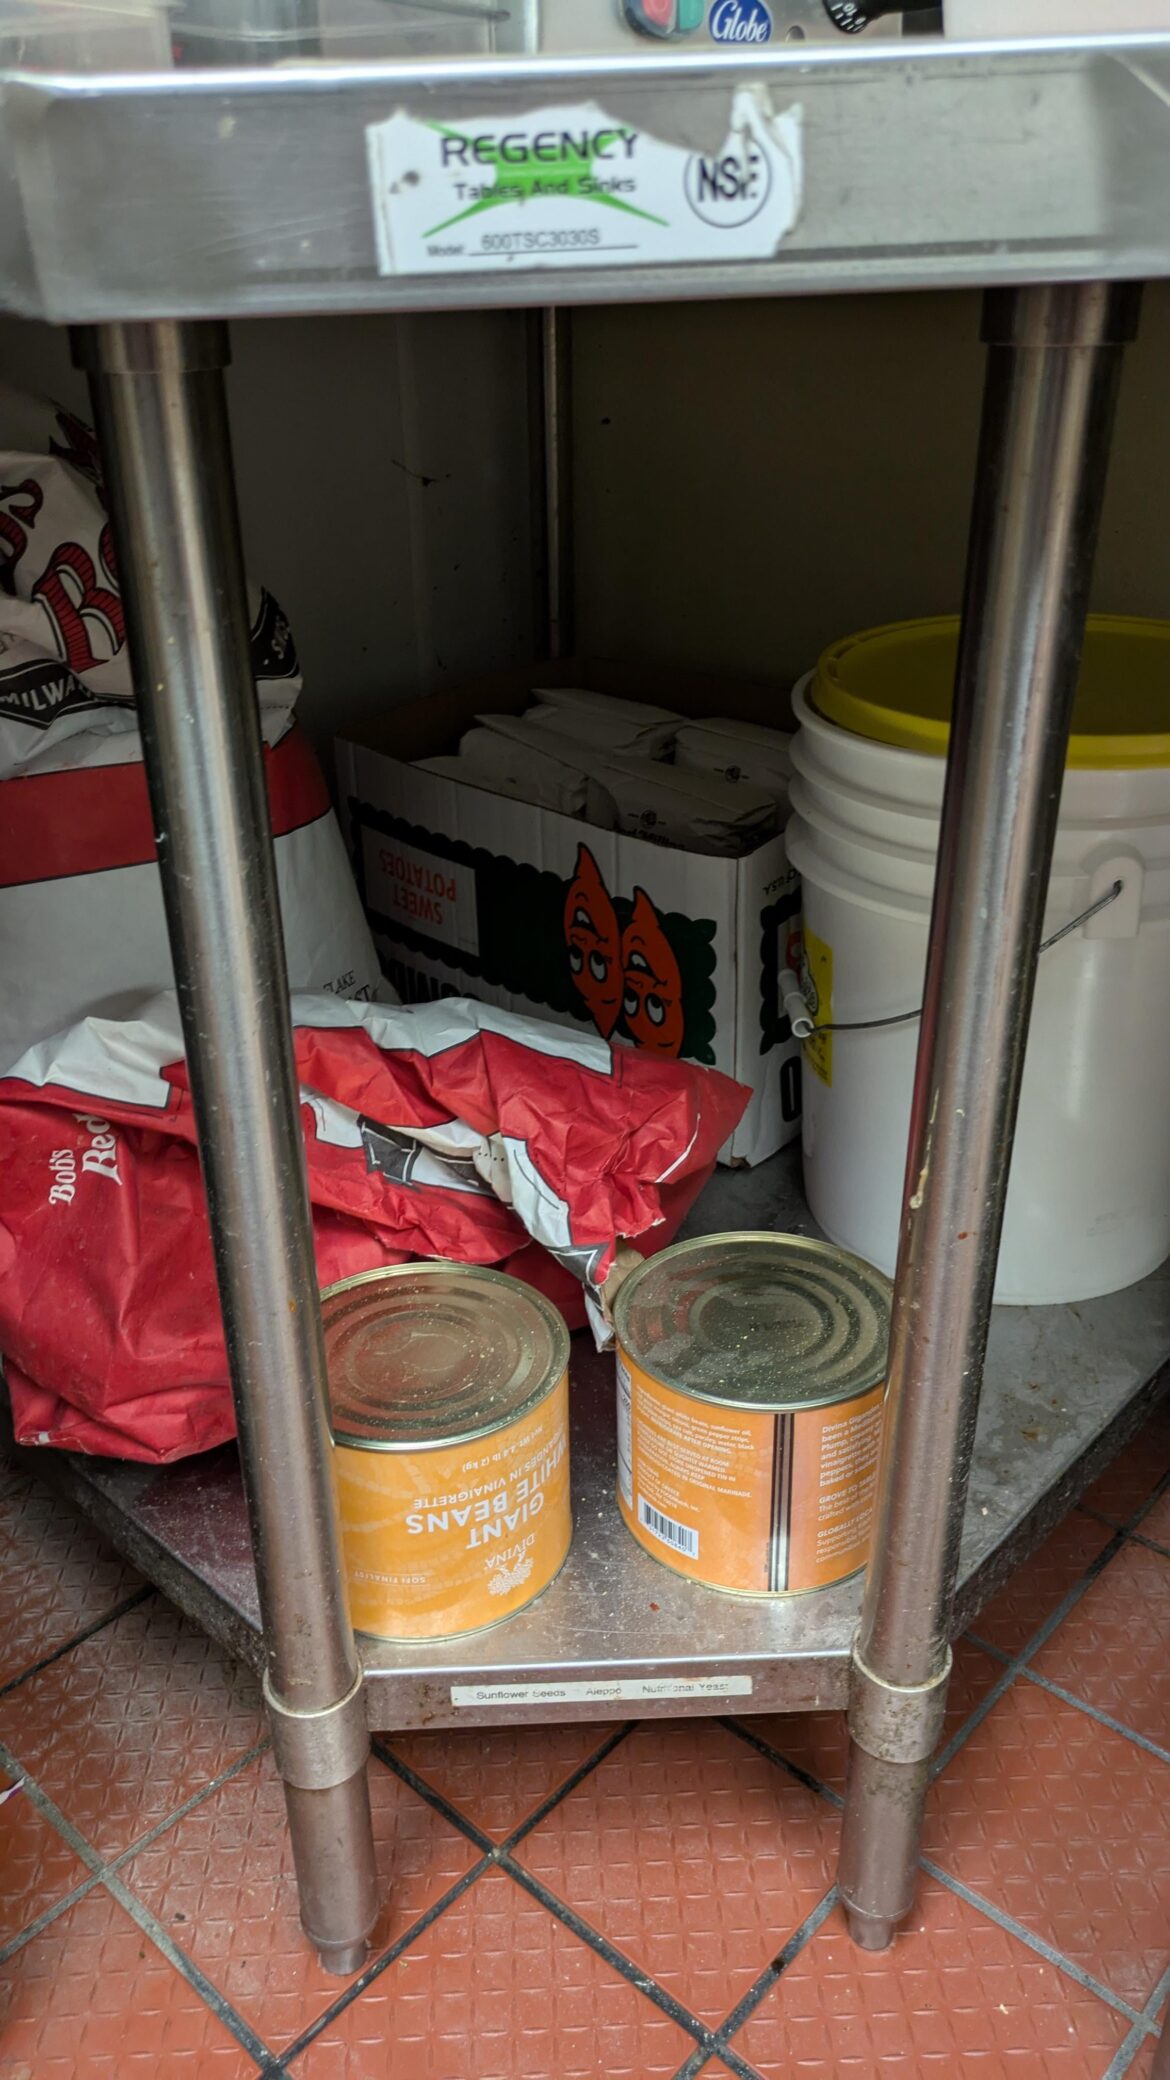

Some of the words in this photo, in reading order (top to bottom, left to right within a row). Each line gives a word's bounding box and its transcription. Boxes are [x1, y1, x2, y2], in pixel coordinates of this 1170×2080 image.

[712, 1, 770, 42] Globe
[441, 129, 638, 167] REGENCY
[455, 180, 525, 202] Tables
[531, 178, 570, 197] And
[578, 175, 637, 195] Sinks
[379, 849, 458, 903] POTATOES
[392, 884, 444, 926] SWEET
[75, 1113, 123, 1186] Red
[49, 1148, 77, 1207] Bob's
[510, 1467, 522, 1482] IN
[517, 1433, 567, 1503] WHITE
[405, 1490, 508, 1535] BEANS
[414, 1477, 506, 1510] VINAIGRETTE
[466, 1493, 544, 1549] GIANT
[485, 1532, 536, 1569] DIVINA
[476, 1690, 529, 1700] Sunflower
[533, 1688, 566, 1698] Seeds
[642, 1684, 694, 1694] Nutronal
